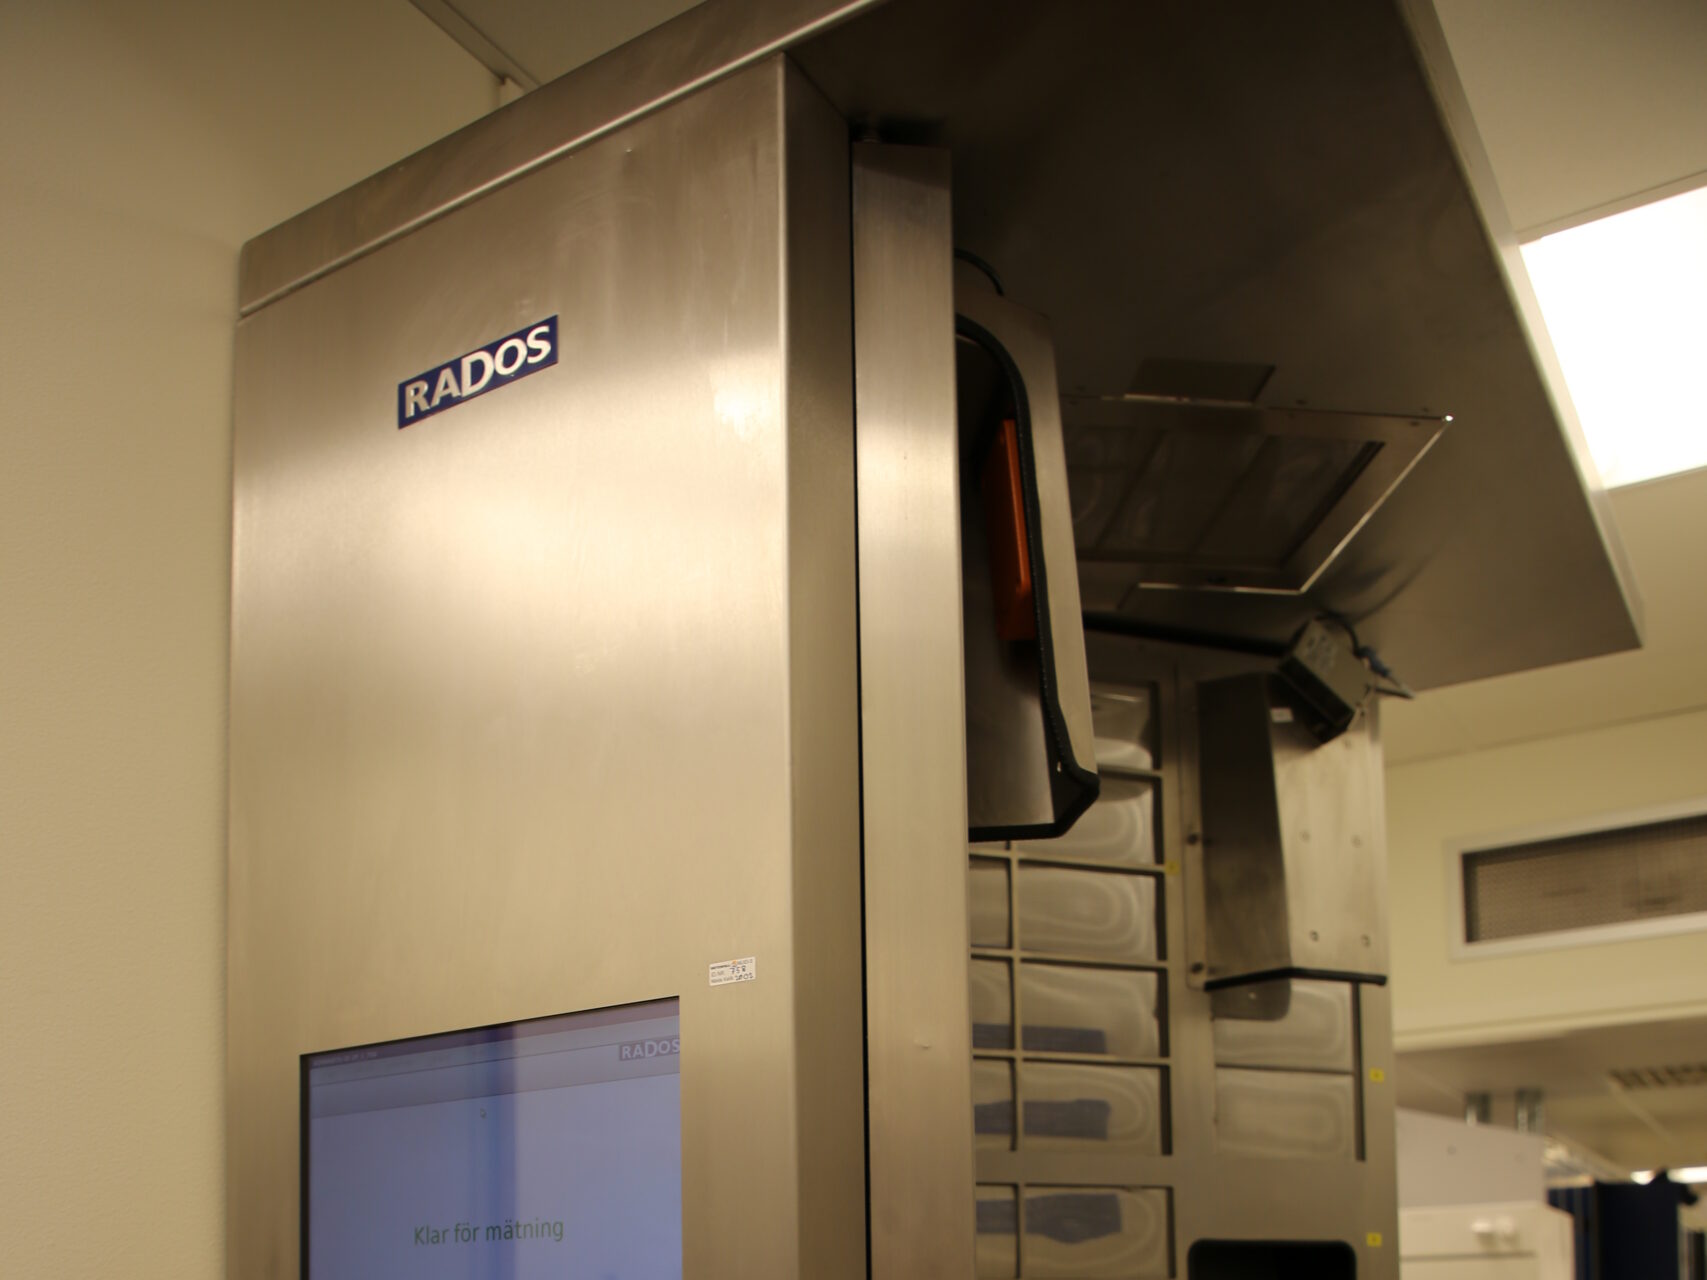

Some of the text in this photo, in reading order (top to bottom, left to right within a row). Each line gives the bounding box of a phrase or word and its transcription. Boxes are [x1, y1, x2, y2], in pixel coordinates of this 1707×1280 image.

[405, 325, 551, 418] RADOS
[622, 1038, 680, 1060] RADOS
[414, 1218, 564, 1245] Klar för mätning
